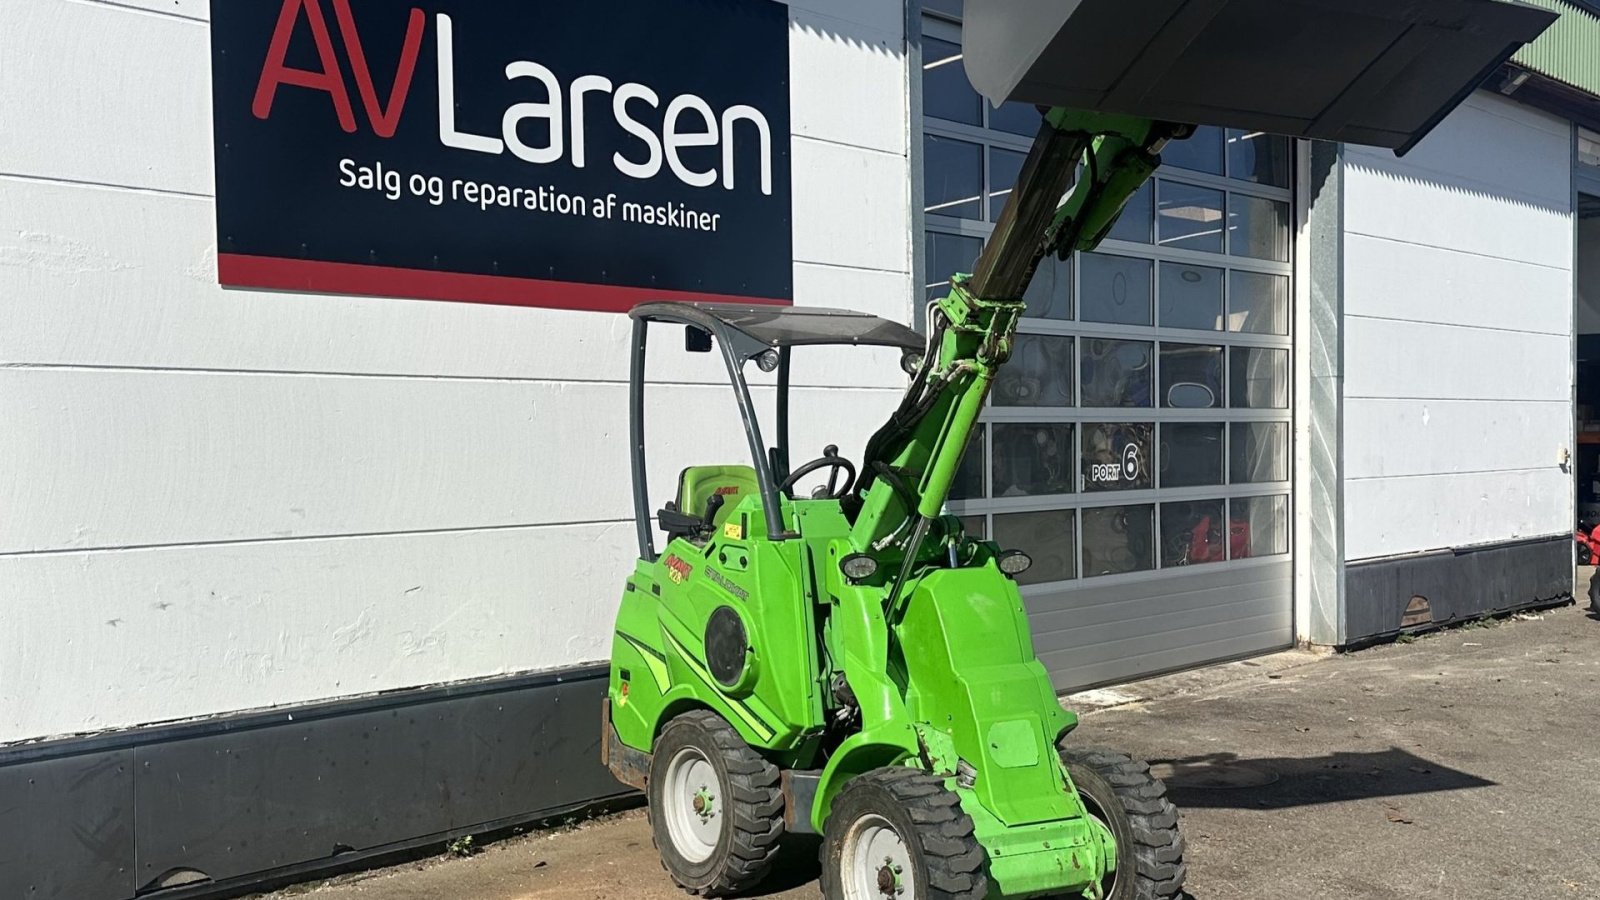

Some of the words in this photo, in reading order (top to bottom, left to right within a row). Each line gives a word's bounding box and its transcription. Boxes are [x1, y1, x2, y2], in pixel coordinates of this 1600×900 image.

[339, 158, 401, 201] Salg
[410, 174, 444, 206] og
[452, 179, 587, 217] reparation
[592, 193, 617, 219] af
[622, 201, 722, 232] maskiner
[1092, 463, 1120, 481] PORT
[1122, 442, 1139, 481] 6
